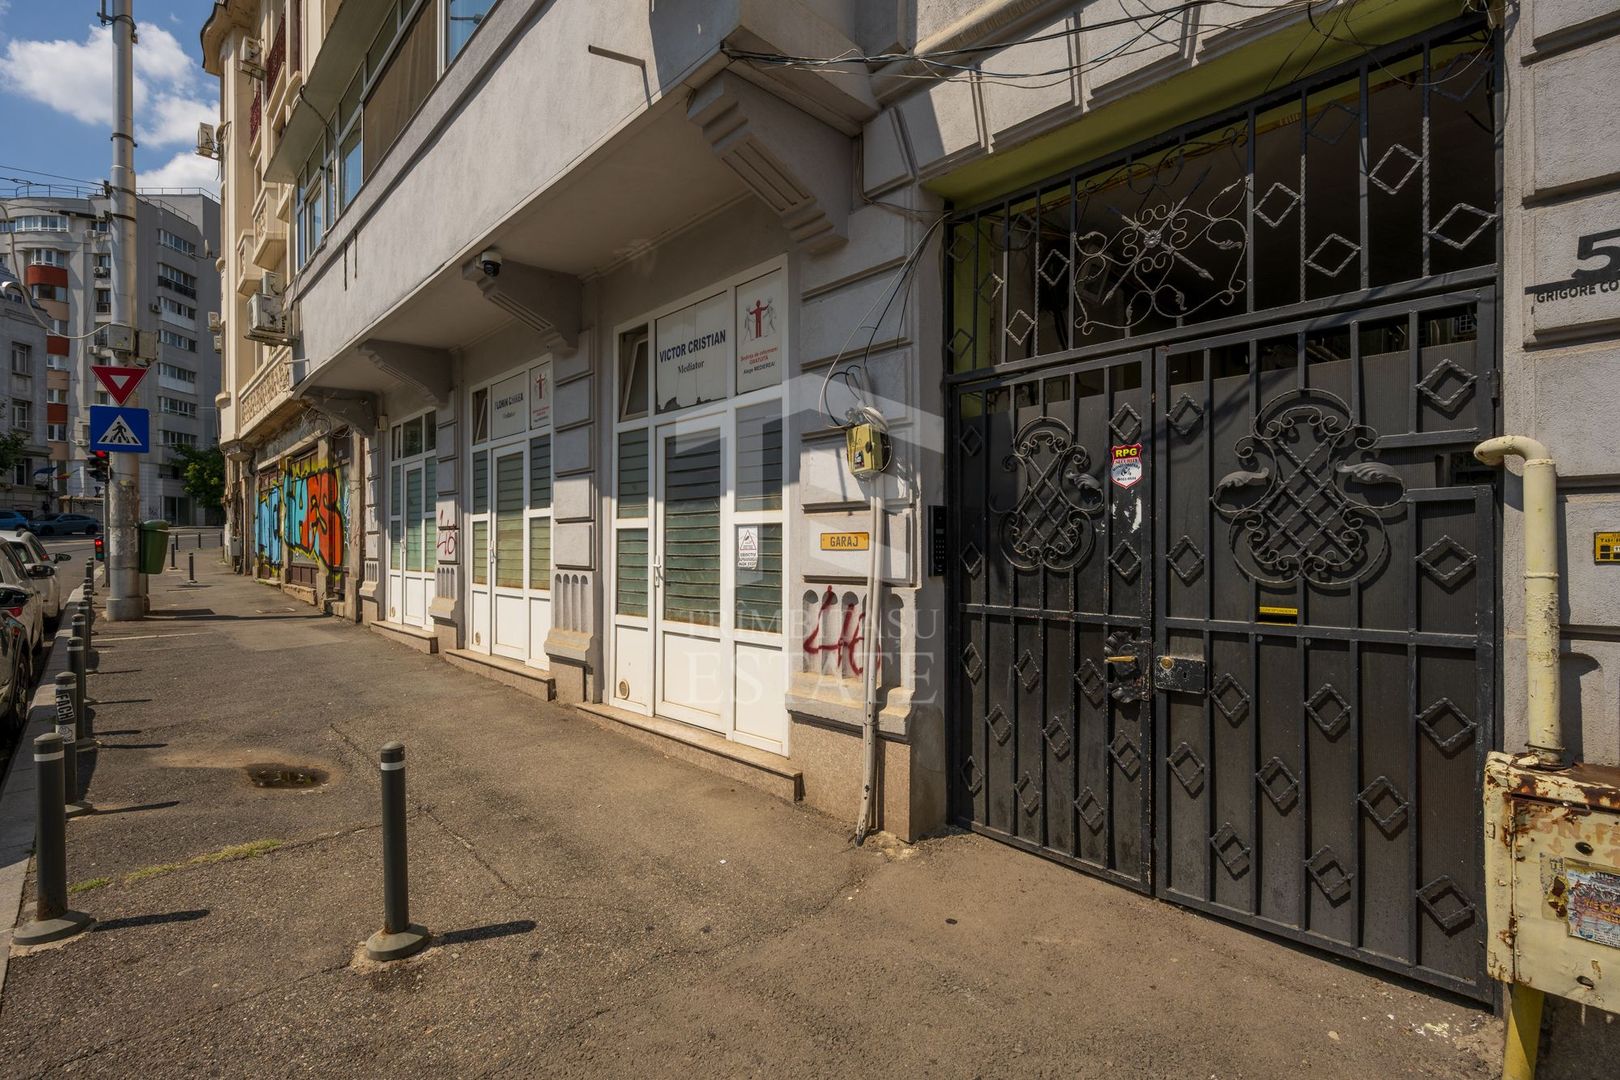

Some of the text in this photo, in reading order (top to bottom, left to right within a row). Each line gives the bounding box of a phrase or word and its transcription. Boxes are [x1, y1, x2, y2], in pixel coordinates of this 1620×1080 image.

[1536, 284, 1597, 303] GRIGORE
[659, 330, 726, 363] VICTOR CRISTIAN
[677, 360, 705, 375] Mediator
[1115, 448, 1138, 457] RPG
[830, 536, 859, 547] GARAJ
